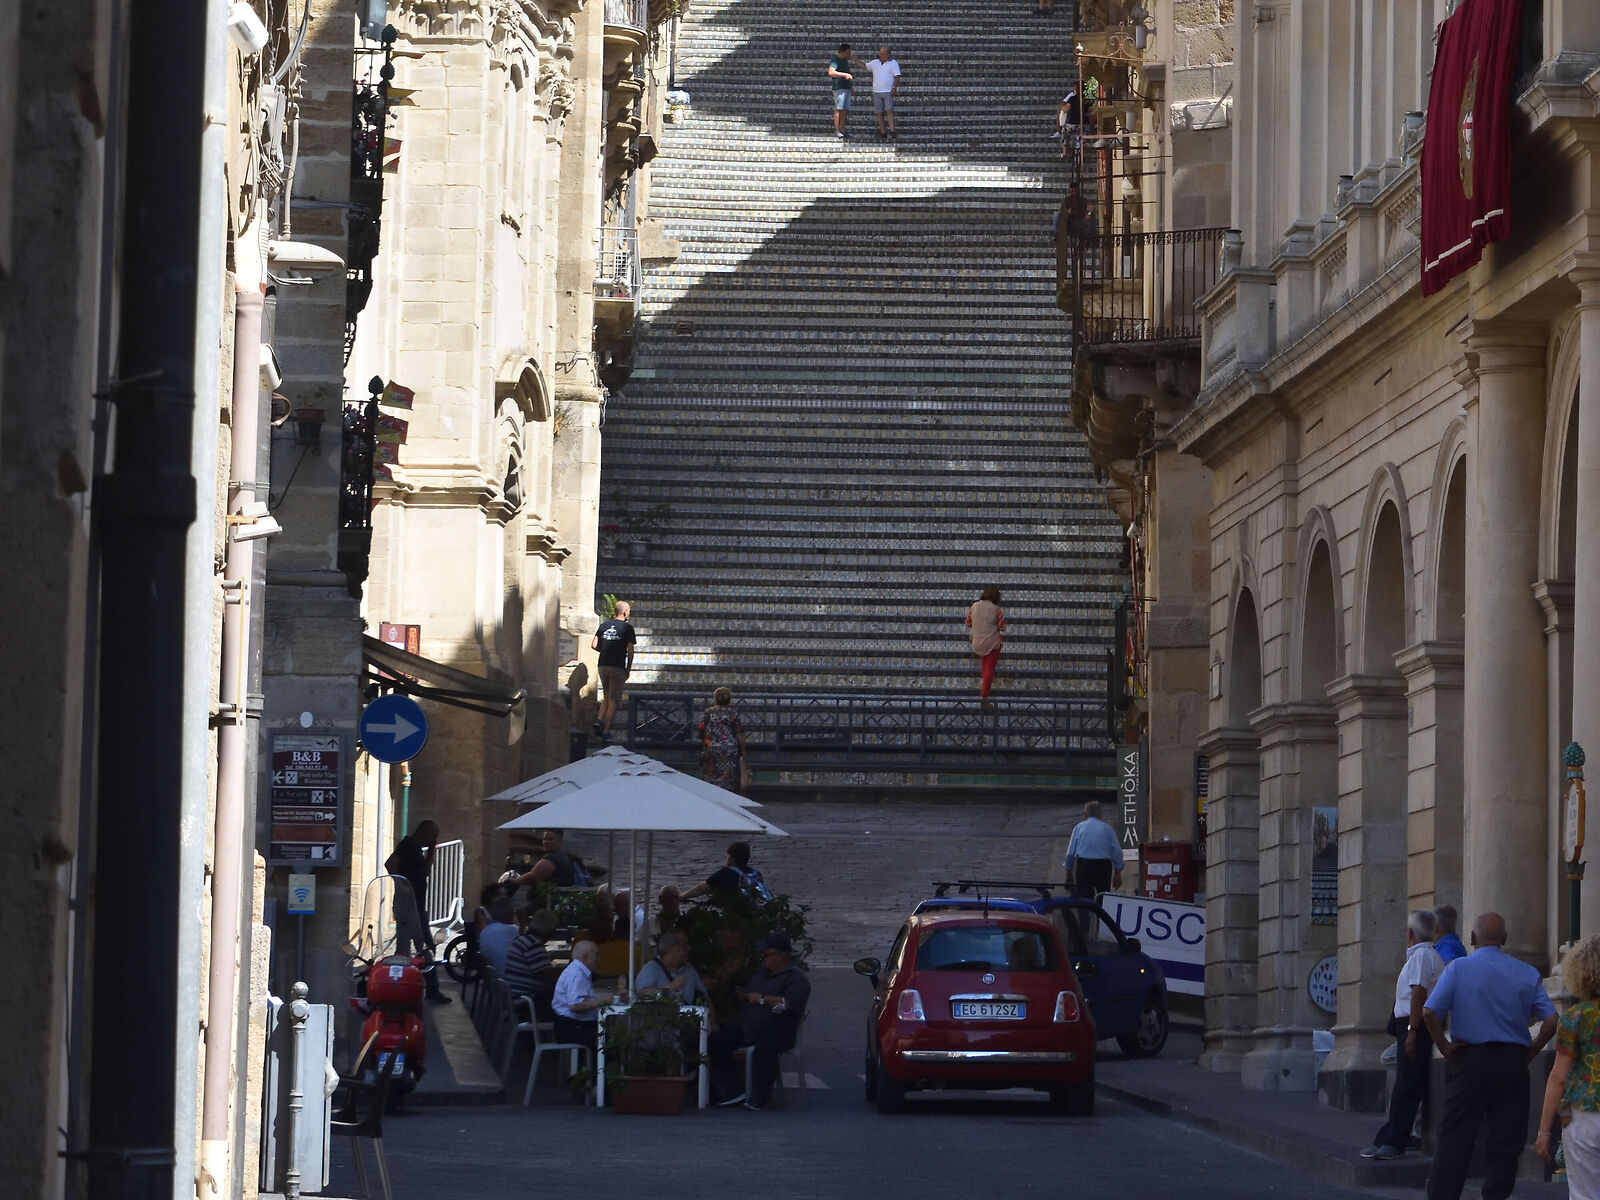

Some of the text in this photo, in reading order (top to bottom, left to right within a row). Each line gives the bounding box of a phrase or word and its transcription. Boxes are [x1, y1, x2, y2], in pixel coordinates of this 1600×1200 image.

[292, 751, 321, 762] B&B
[1120, 751, 1136, 825] ETHÒKA
[962, 1004, 1017, 1016] EG 612SZ
